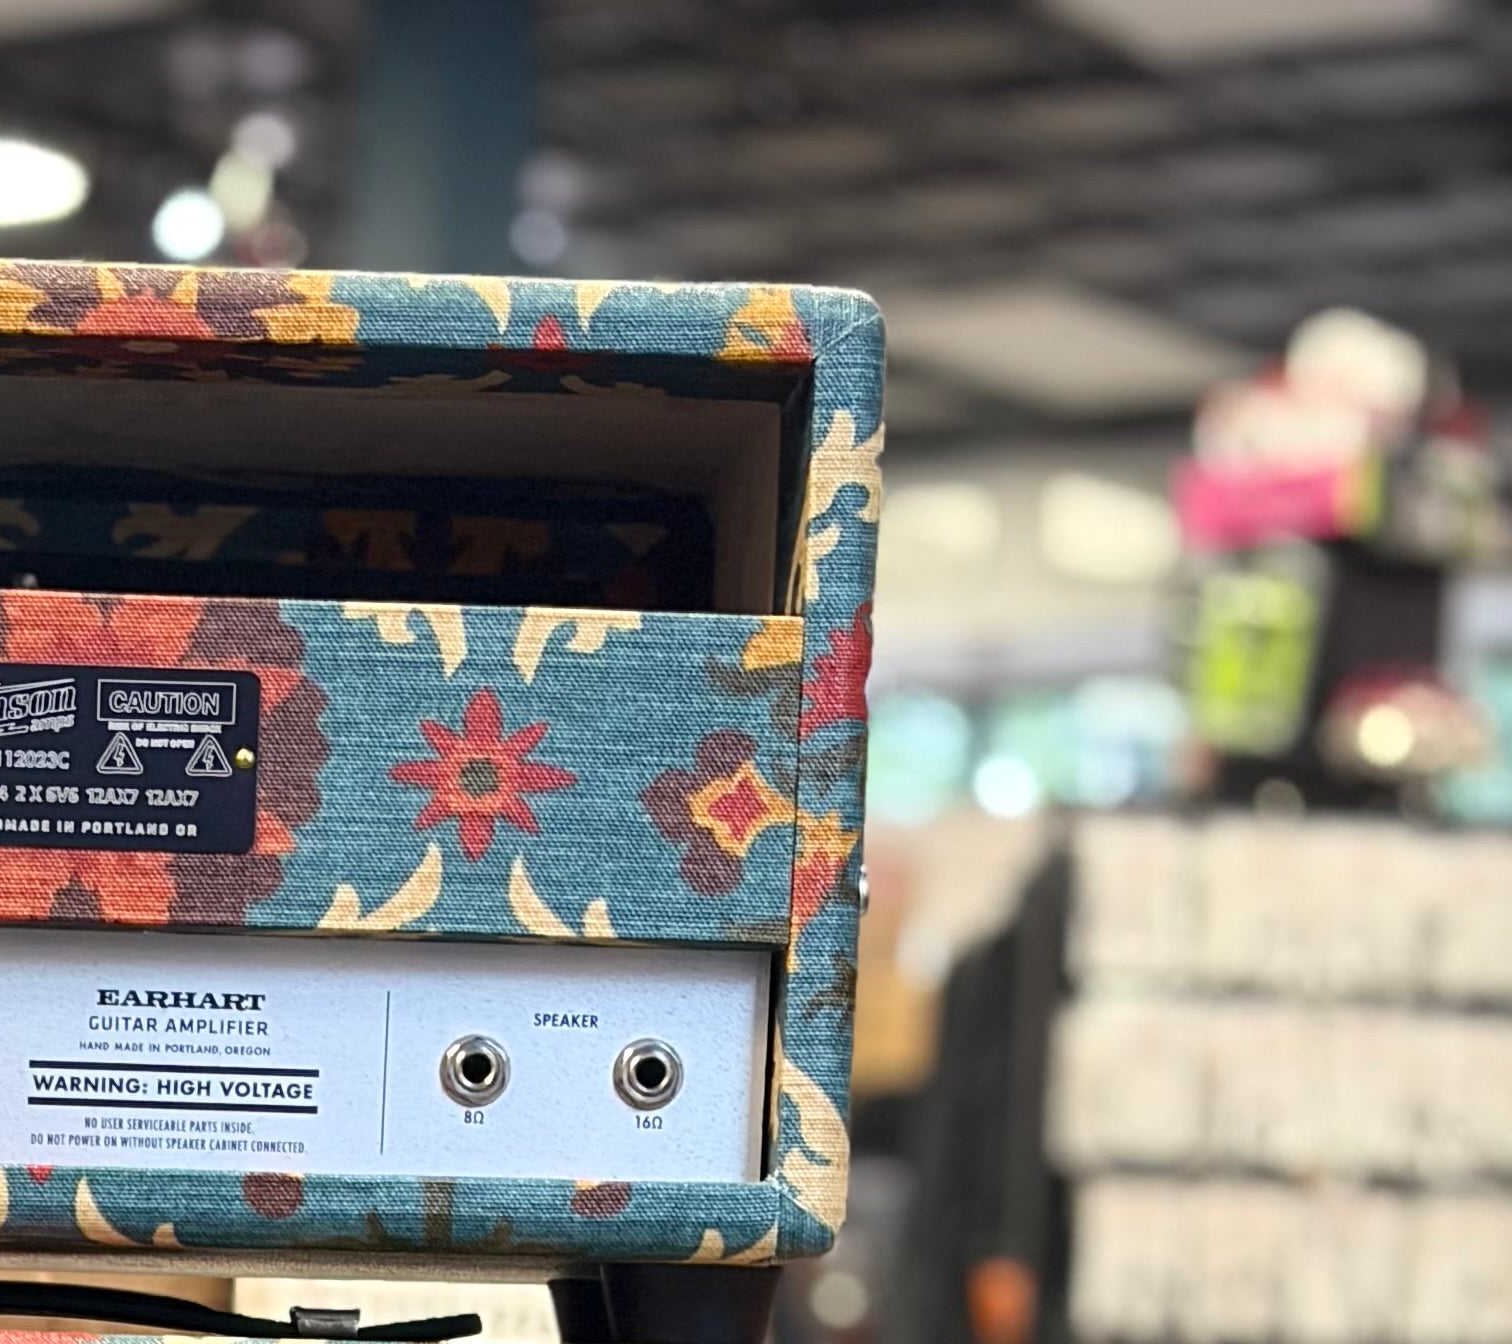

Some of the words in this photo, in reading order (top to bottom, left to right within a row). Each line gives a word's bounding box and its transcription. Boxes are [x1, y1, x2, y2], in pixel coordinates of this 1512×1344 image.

[109, 690, 220, 716] CAUTION
[30, 714, 75, 734] amps
[14, 785, 27, 802] 2
[28, 785, 43, 802] X
[86, 787, 139, 805] 12AX7
[145, 789, 200, 807] 12AX7
[56, 820, 75, 833] IN
[81, 821, 169, 836] PORTLAND
[175, 824, 197, 837] OR
[97, 989, 266, 1011] EARHART
[88, 1015, 158, 1033] GUITAR
[165, 1018, 269, 1036] AMPLIFIER
[534, 1013, 599, 1028] SPEAKER
[79, 1041, 110, 1051] HAND
[114, 1043, 144, 1052] MADE
[148, 1044, 161, 1053] IN
[165, 1044, 222, 1056] PORTLAND,
[224, 1046, 271, 1056] OREGON
[33, 1074, 148, 1094] WARNING:
[157, 1079, 211, 1096] HIGH
[220, 1081, 313, 1099] VOLTAGE
[84, 1117, 98, 1129] NO
[101, 1118, 124, 1130] USER
[127, 1118, 186, 1132] SERVICEABLE
[189, 1120, 218, 1133] PARTS
[463, 1111, 485, 1125] 8Ω
[635, 1115, 663, 1130] 16Ω
[30, 1133, 44, 1145] DO
[47, 1134, 66, 1146] NOT
[69, 1135, 100, 1147] POWER
[104, 1136, 117, 1147] ON
[120, 1136, 162, 1149] WITHOUT
[166, 1138, 206, 1150] SPEAKER
[209, 1139, 248, 1151] CABINET
